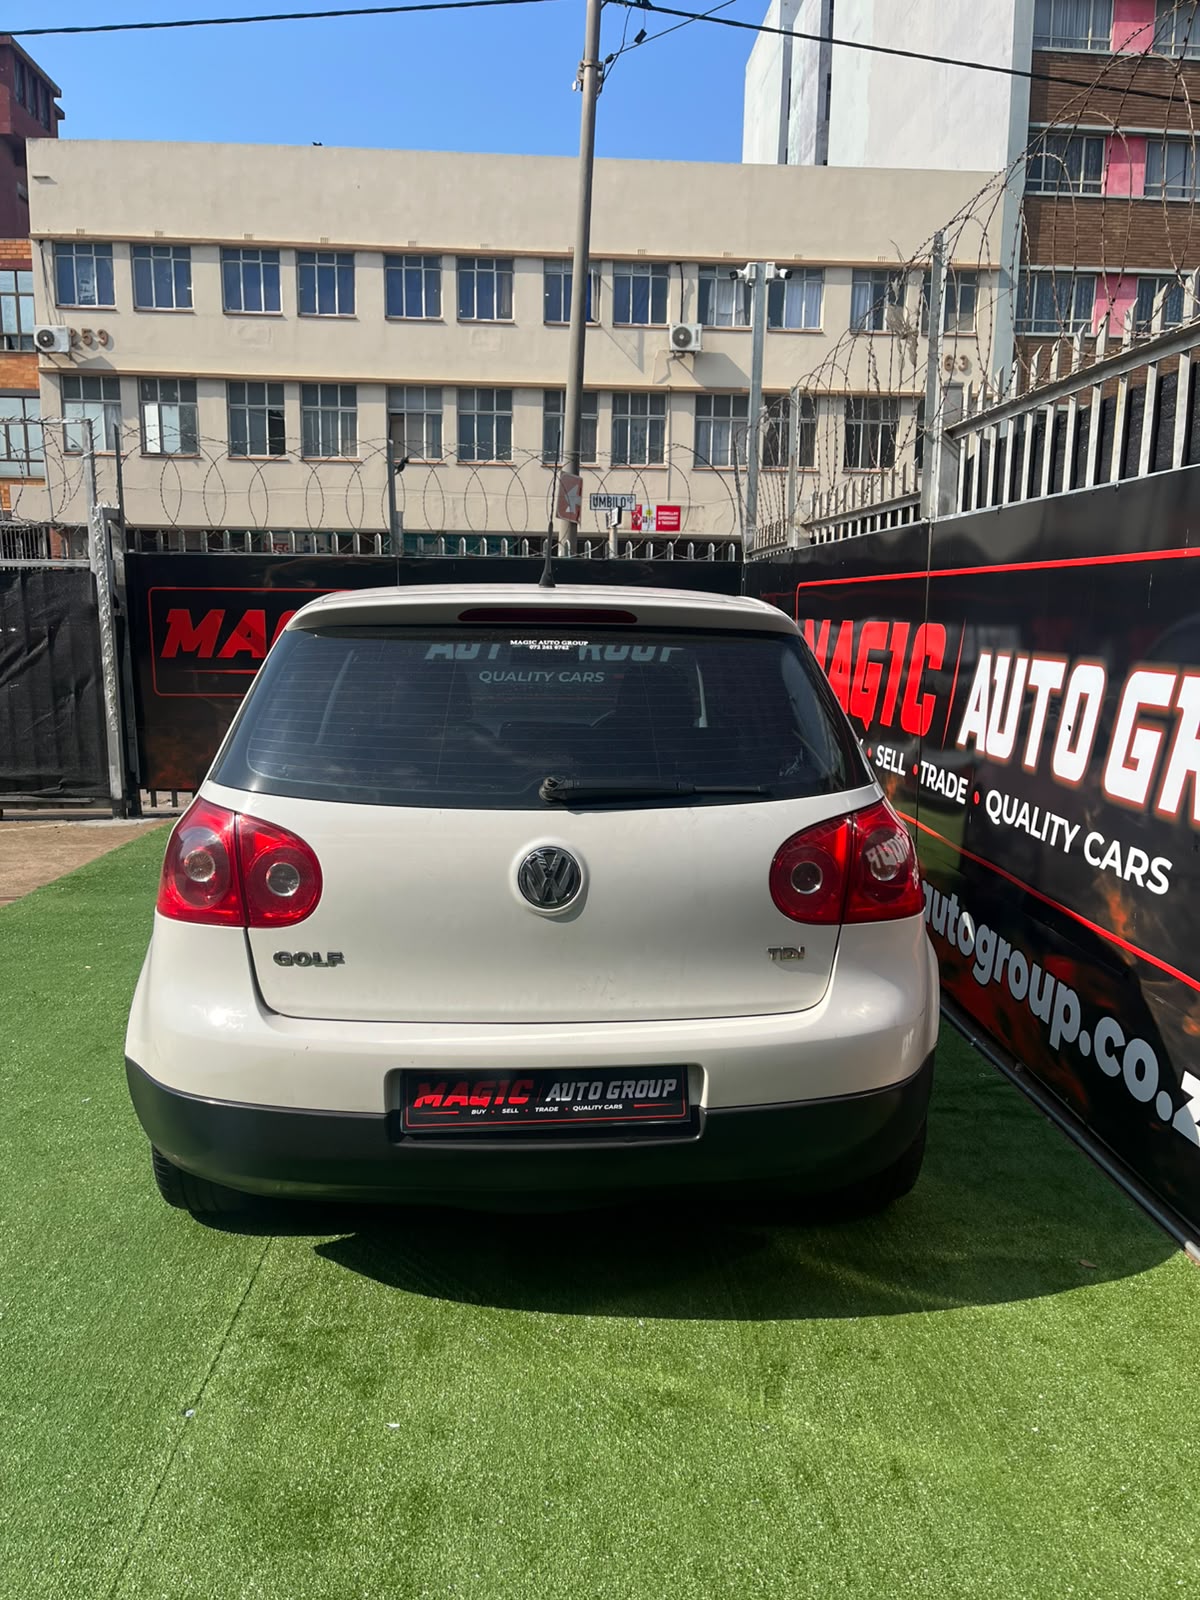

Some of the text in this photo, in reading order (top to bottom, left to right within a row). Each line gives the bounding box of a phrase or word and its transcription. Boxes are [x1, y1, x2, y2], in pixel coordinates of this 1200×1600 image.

[592, 495, 626, 508] UMBILO
[479, 671, 605, 684] QUALITY CARS
[956, 653, 1106, 783] AUTO
[875, 744, 1174, 896] SELL TRADE QUALITY CARS
[273, 951, 346, 968] GOLF
[413, 1079, 678, 1108] MAGIC AUTO GROUP
[572, 1104, 603, 1112] QUALITY
